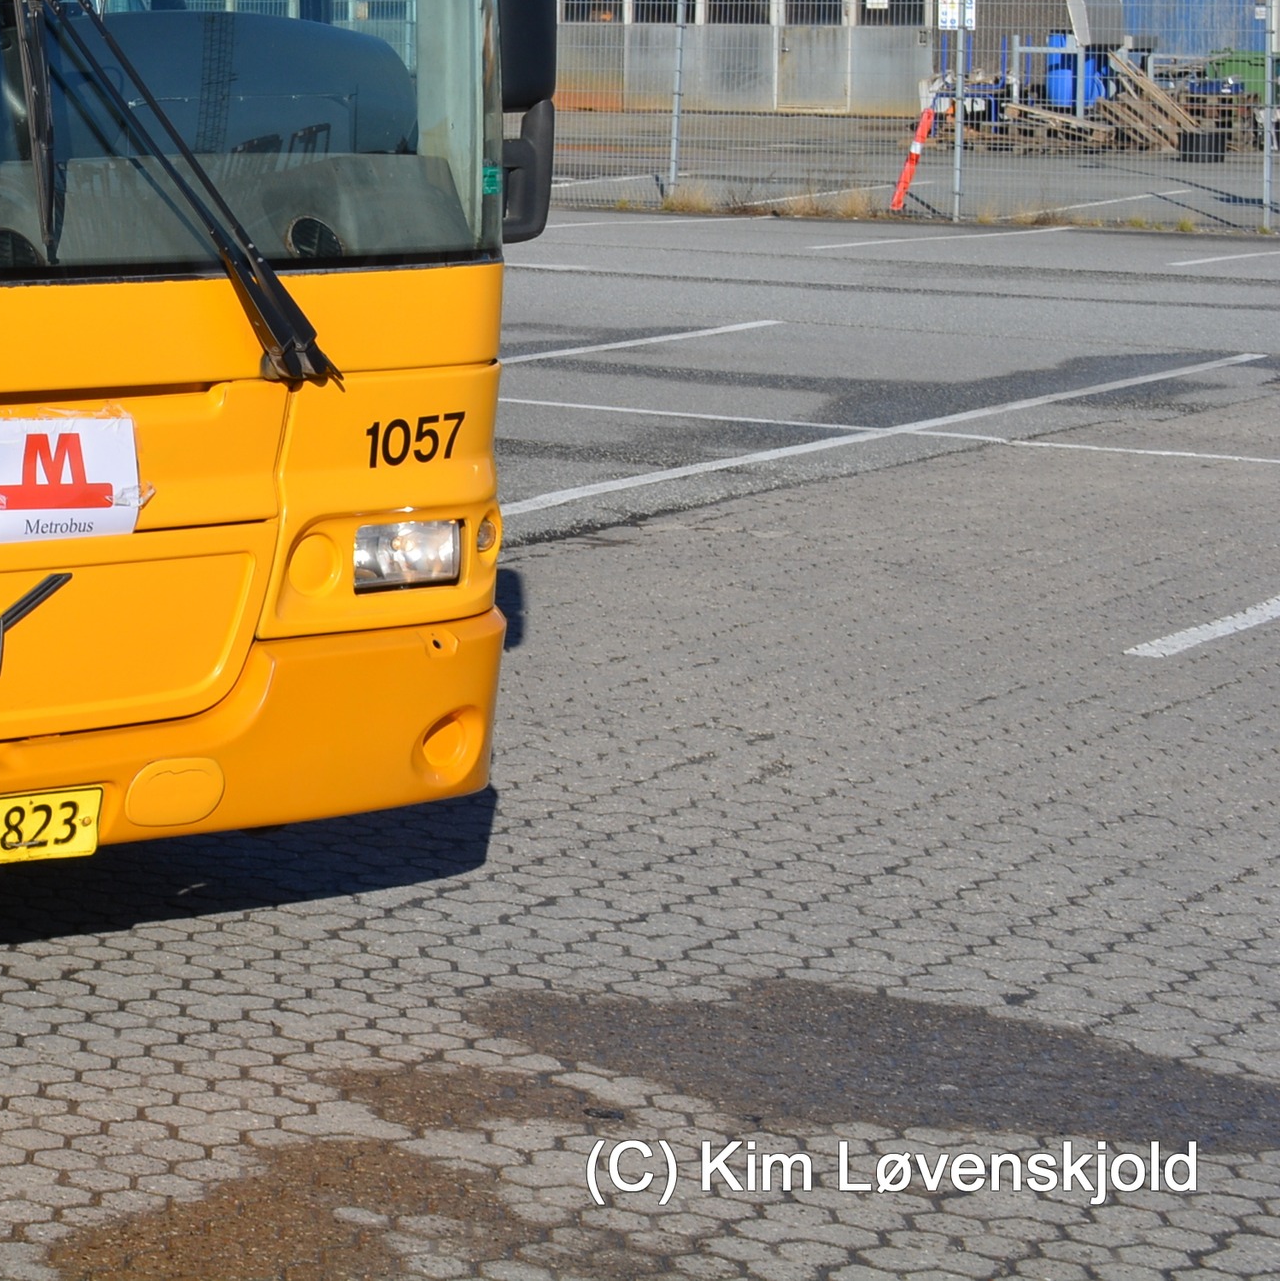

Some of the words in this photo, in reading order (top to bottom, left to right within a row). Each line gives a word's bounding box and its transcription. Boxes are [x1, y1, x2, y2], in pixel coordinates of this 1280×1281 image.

[21, 432, 87, 486] M
[365, 411, 466, 469] 1057
[23, 517, 94, 536] Metrobus
[0, 800, 80, 851] 823
